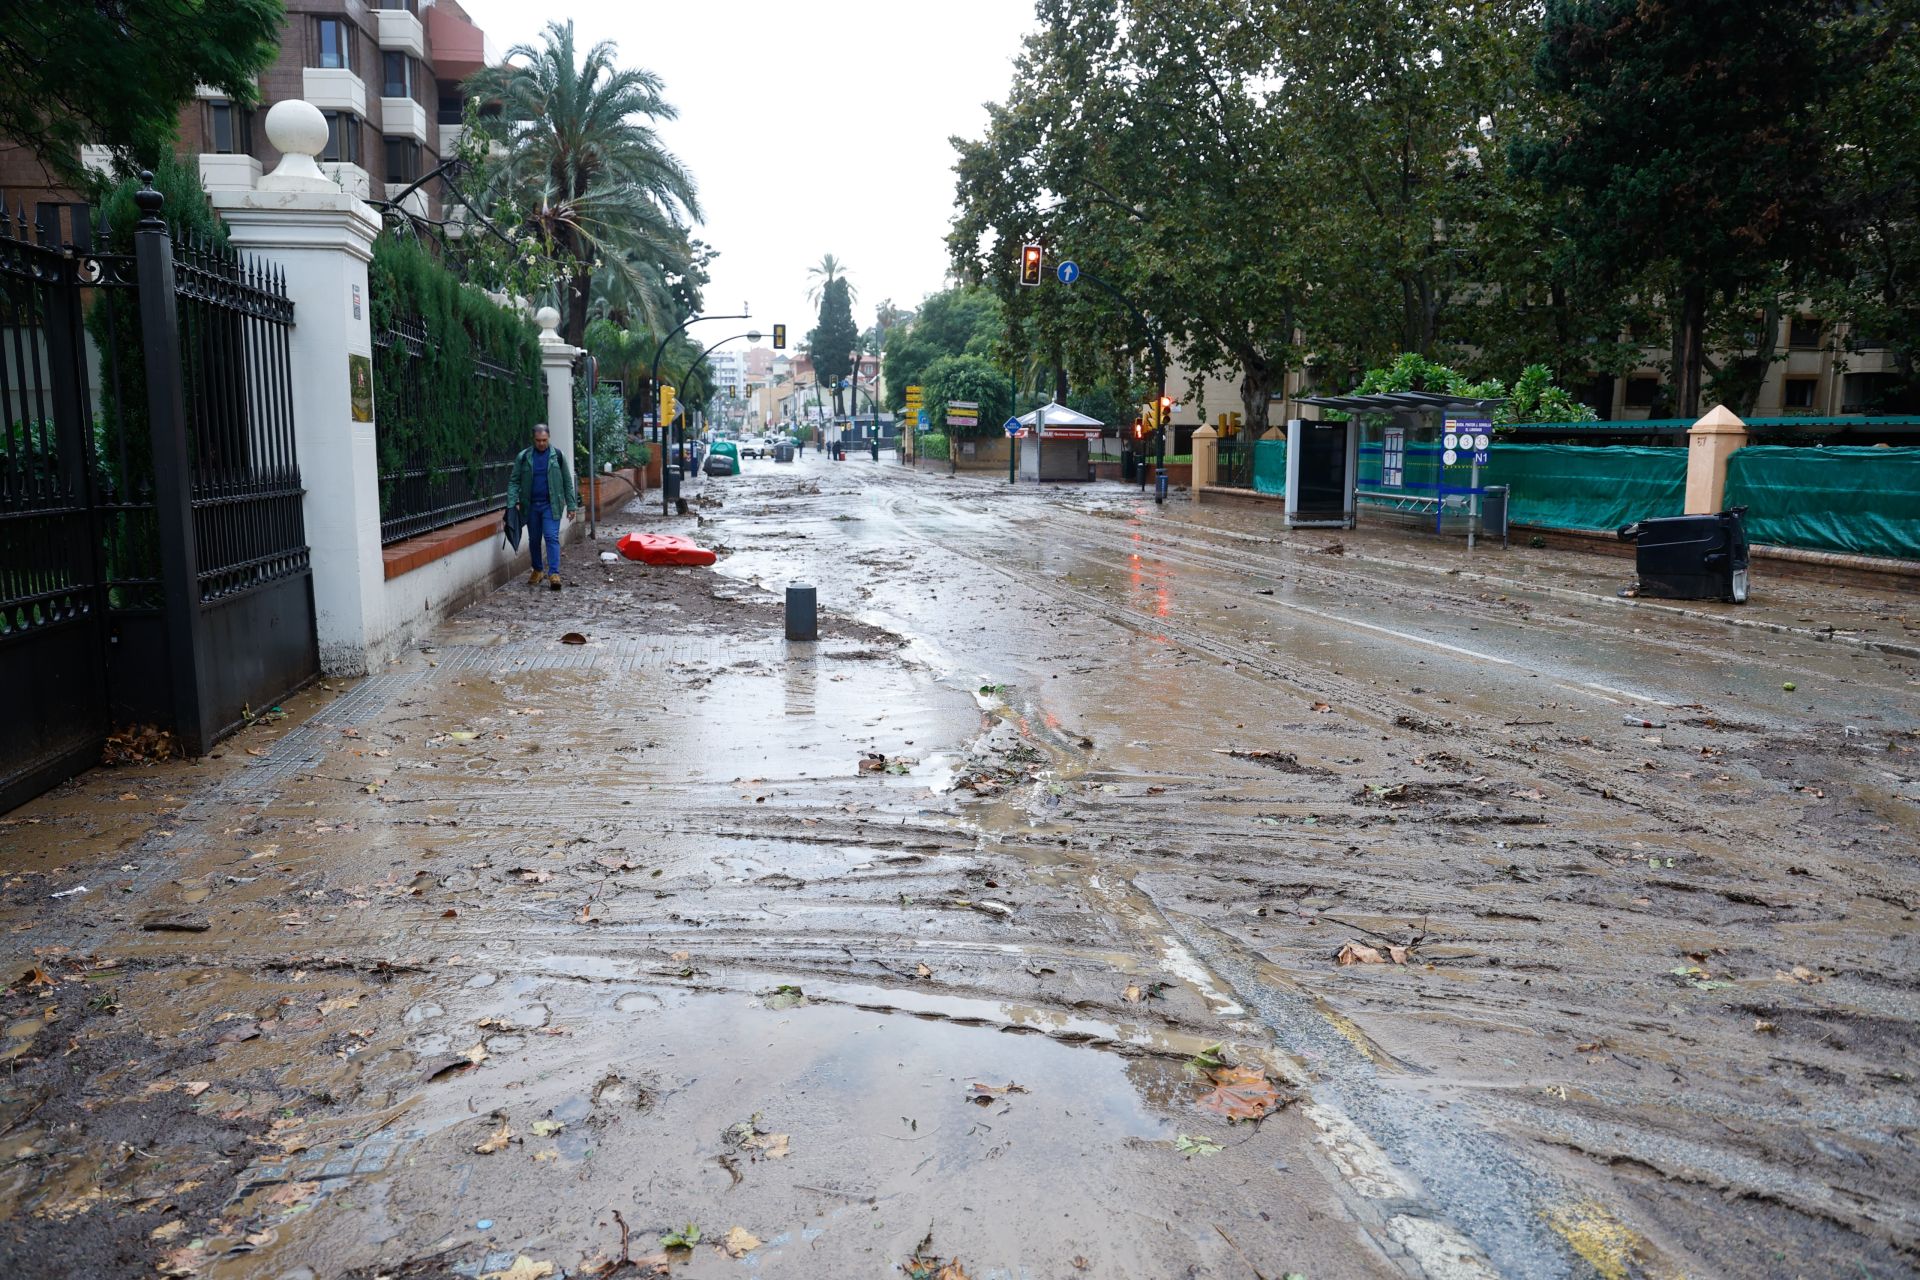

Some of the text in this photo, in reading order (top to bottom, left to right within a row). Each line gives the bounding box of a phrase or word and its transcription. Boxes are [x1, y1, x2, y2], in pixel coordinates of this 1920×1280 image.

[1446, 437, 1487, 446] 11 3 33
[1476, 453, 1487, 462] N1
